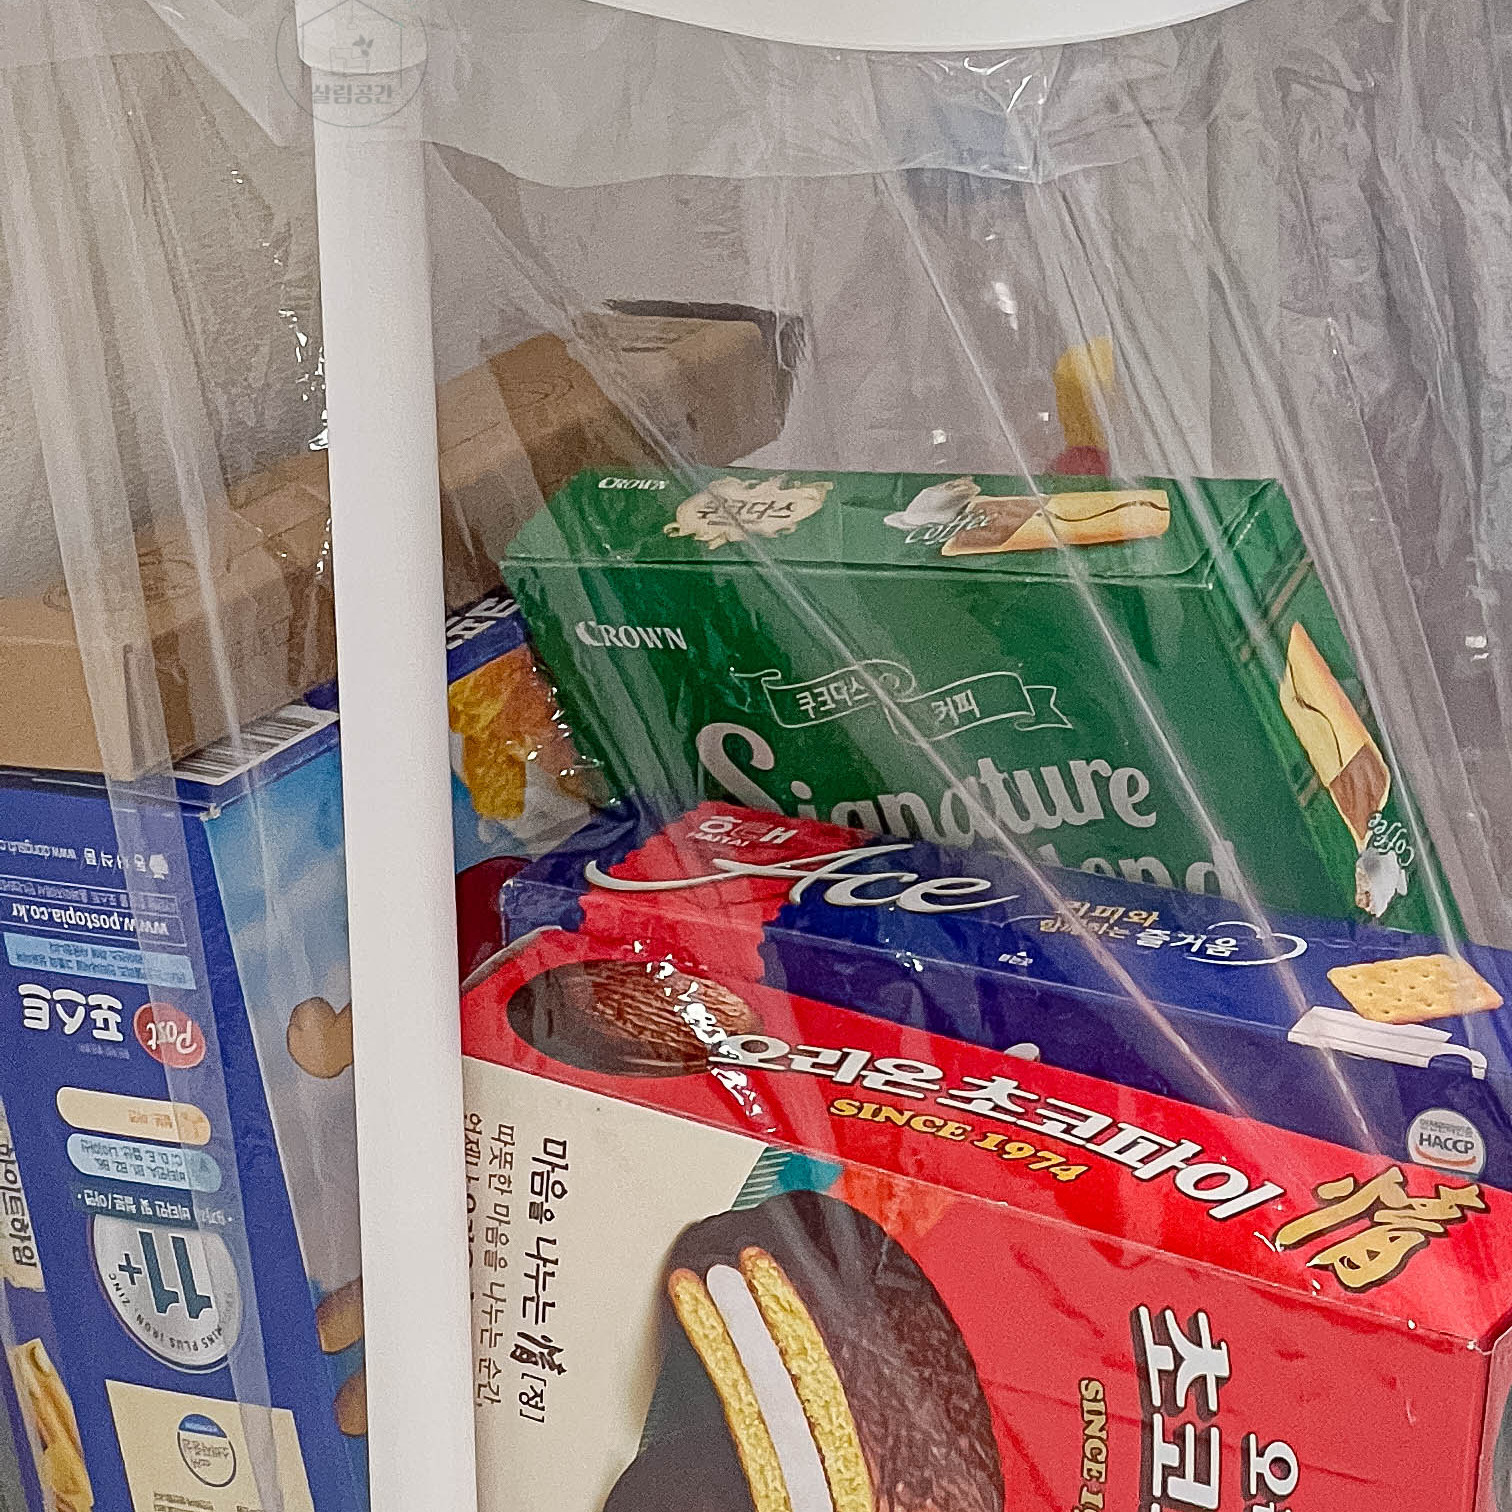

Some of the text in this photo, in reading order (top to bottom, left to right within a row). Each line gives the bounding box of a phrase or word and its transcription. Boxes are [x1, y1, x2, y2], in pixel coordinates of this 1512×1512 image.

[598, 476, 669, 491] CROWN
[575, 620, 689, 652] CROWN
[932, 689, 980, 725] 커피
[584, 844, 1020, 914] Ace
[11, 902, 168, 935] www.postopia.co.kr
[1135, 928, 1239, 958] 즐거움
[18, 983, 124, 1043] 포스트
[145, 1018, 197, 1052] Post
[487, 1122, 517, 1197] 따뜻한
[706, 1035, 1285, 1219] 오리온 초코파이
[830, 1098, 1090, 1184] SINCE 1974
[1419, 1132, 1475, 1155] HACCP
[155, 1199, 190, 1220] 비타민
[529, 1137, 569, 1225] 마음을
[483, 1203, 513, 1273] 마음을
[118, 1229, 213, 1319] 11+
[522, 1234, 562, 1327] 나누는
[480, 1279, 508, 1351] 나누는
[1079, 1379, 1107, 1483] SINCE
